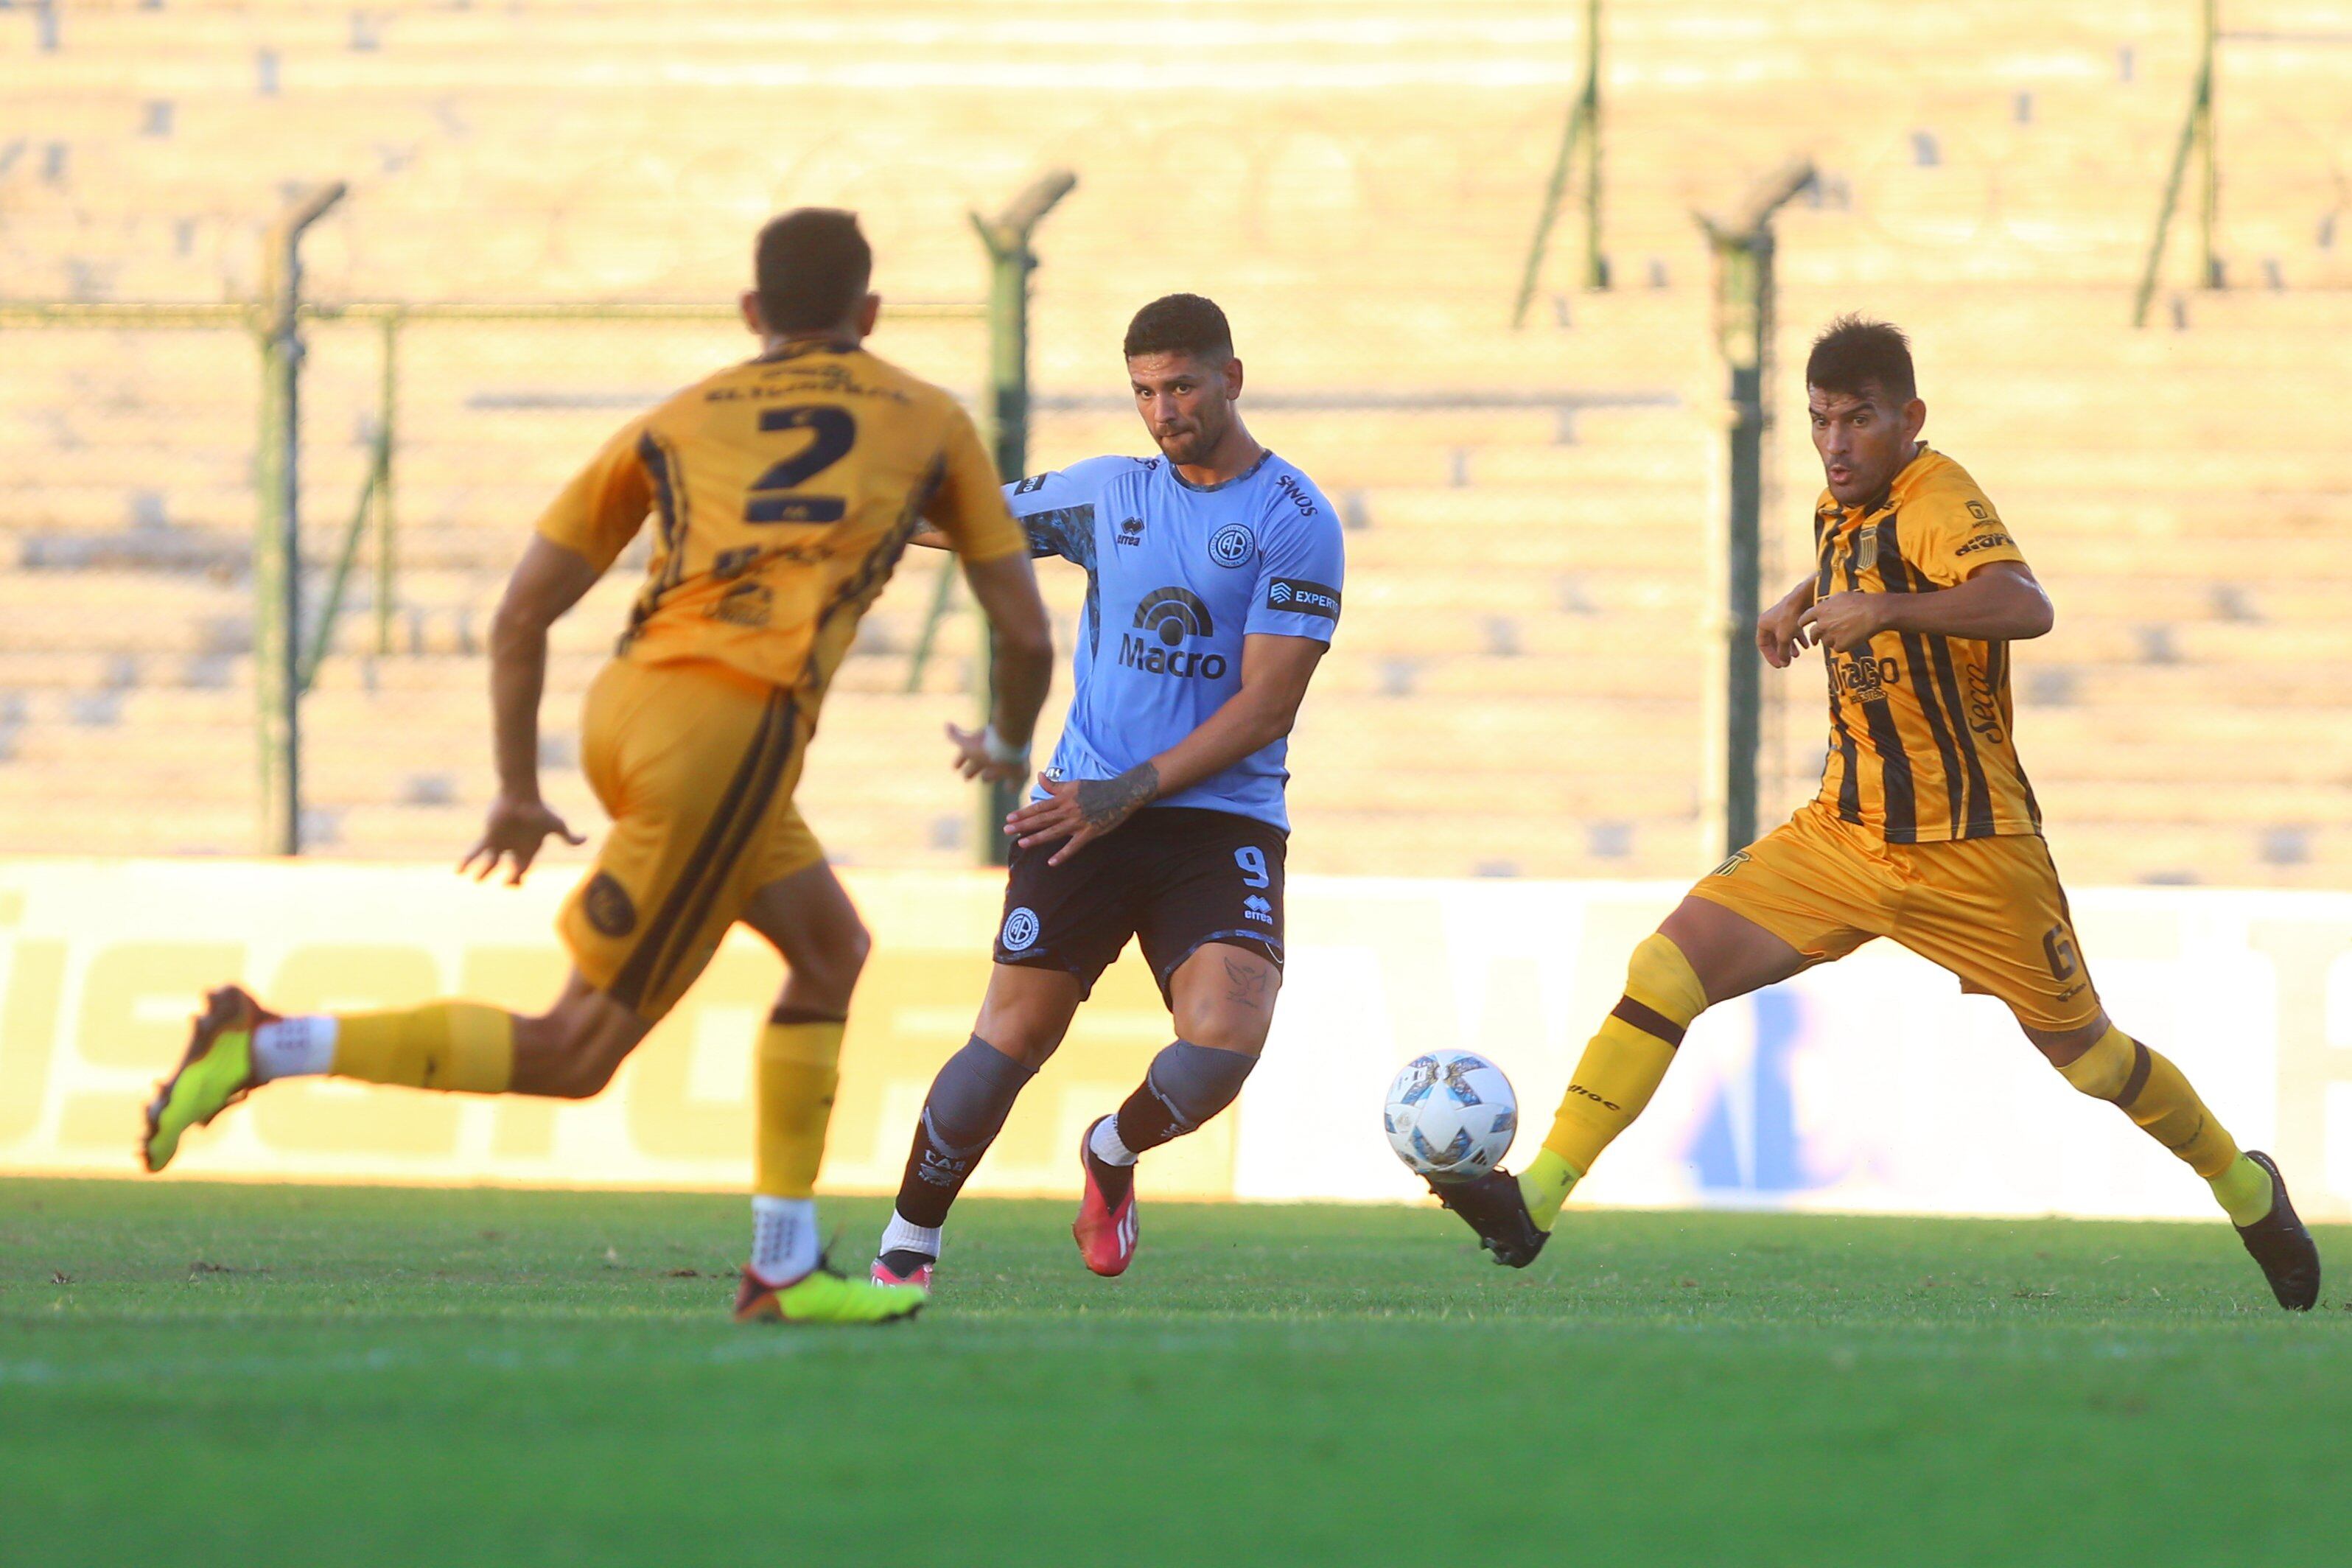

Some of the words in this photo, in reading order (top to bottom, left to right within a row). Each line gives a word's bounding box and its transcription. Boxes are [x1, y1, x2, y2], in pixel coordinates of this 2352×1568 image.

[745, 404, 857, 522] 2
[1275, 475, 1317, 517] SANOS
[1119, 633, 1227, 679] Macro
[1967, 663, 2003, 744] Secco
[1233, 846, 1269, 889] 9
[2043, 921, 2076, 981] 6
